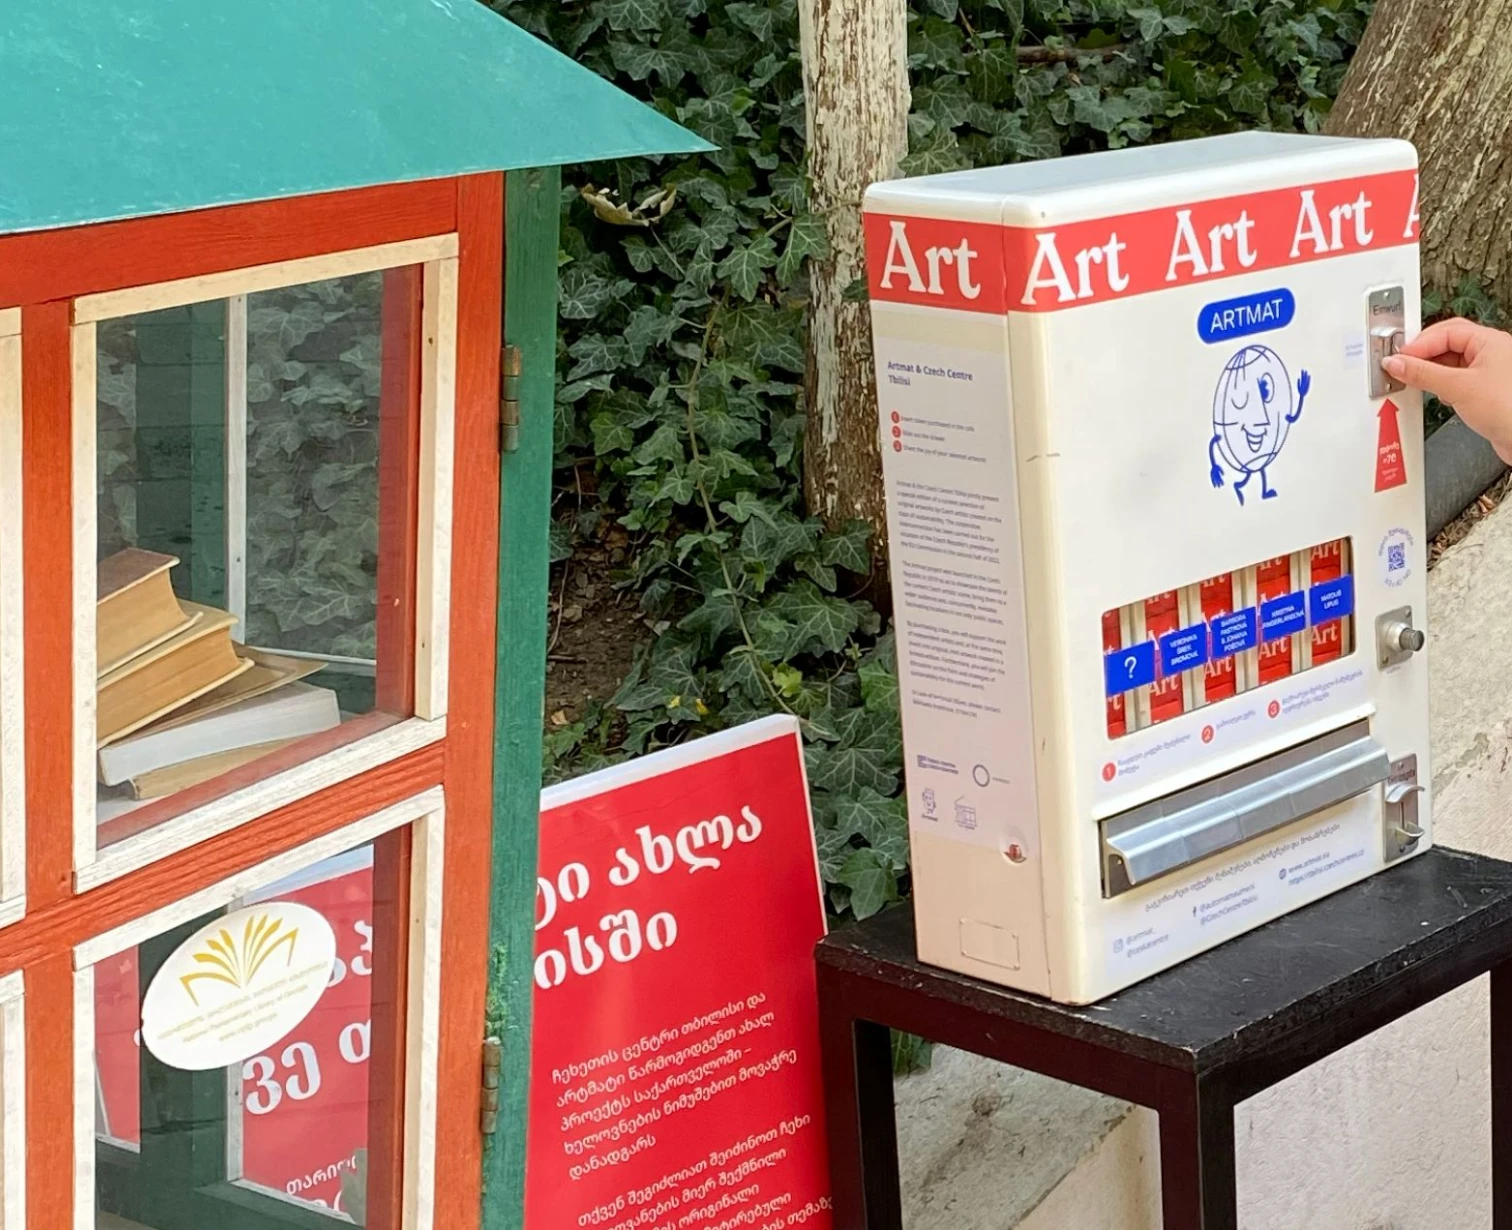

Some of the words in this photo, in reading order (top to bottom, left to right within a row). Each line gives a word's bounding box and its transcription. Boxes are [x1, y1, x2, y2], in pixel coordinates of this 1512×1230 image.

[879, 220, 981, 300] Art
[1021, 232, 1131, 306] Art
[1165, 209, 1257, 282] Art
[1288, 190, 1373, 258] Art
[1210, 298, 1284, 334] ARTMAT
[887, 361, 915, 373] Artmat
[923, 366, 946, 378] Czech
[947, 369, 974, 381] Centre
[1258, 636, 1289, 660] Art
[1310, 624, 1339, 646] Art
[1149, 674, 1178, 697] Art
[1204, 655, 1233, 681] Art
[608, 805, 762, 887] ახლა
[551, 1046, 618, 1084] ჩეხეთის
[621, 1029, 679, 1062] ცენტრი
[681, 1002, 744, 1035] თბილისი
[746, 992, 766, 1010] და
[556, 1074, 625, 1108] არტმატი
[738, 1012, 774, 1035] ახალ
[560, 1097, 631, 1132] პროექტს
[633, 1049, 742, 1104] საქართველოში
[564, 1110, 661, 1155] ხელოვნების
[663, 1076, 737, 1115] ნიმუშებით
[738, 1049, 798, 1080] მოვაჭრე
[568, 1134, 657, 1181] დანადგარს
[578, 1195, 626, 1227] თქვენ
[627, 1160, 707, 1205] შეგიძლიათ
[709, 1131, 777, 1166] შეიძინოთ
[779, 1114, 811, 1136] ჩეხი
[682, 1177, 717, 1204] მიერ
[717, 1148, 787, 1187] შექმნილი
[678, 1183, 760, 1229] ორიგინალი
